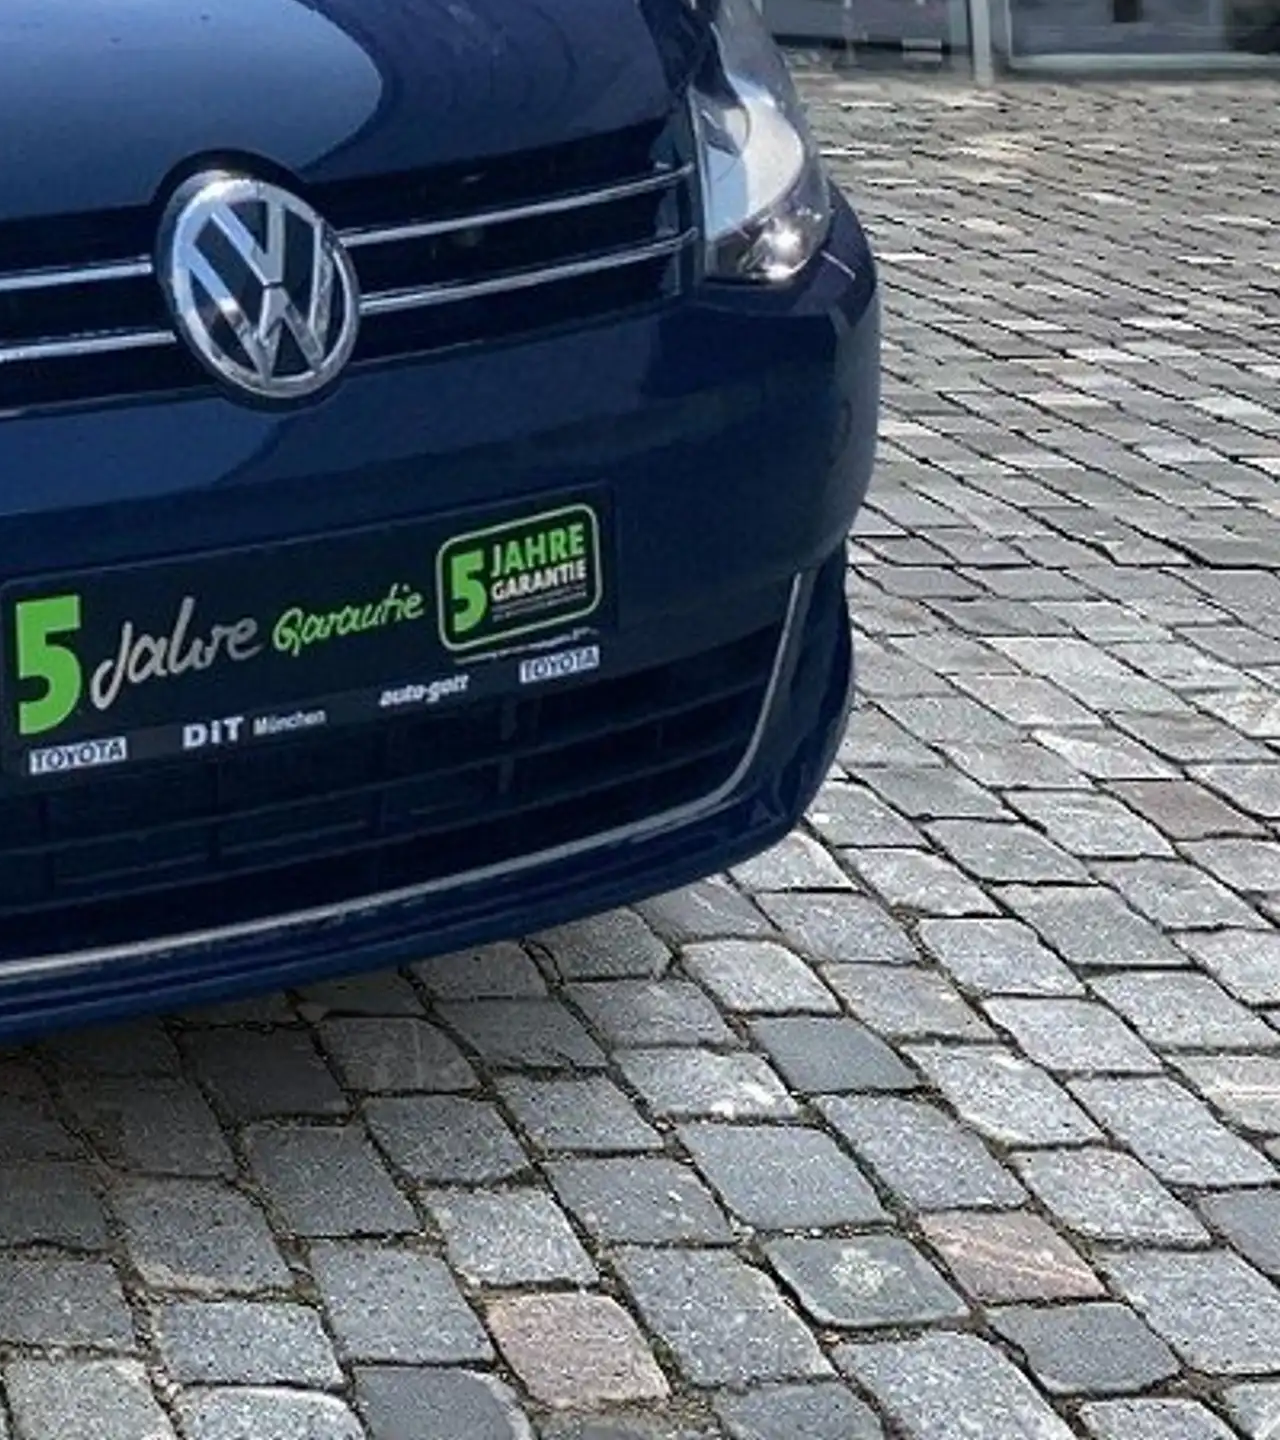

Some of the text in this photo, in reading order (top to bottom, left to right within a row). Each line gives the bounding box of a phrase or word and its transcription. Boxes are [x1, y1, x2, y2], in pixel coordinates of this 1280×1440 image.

[490, 522, 586, 579] JAHRE
[450, 548, 488, 634] 5
[491, 558, 588, 602] GARANTIE
[15, 594, 82, 736] 5
[88, 595, 264, 711] Jahre
[519, 646, 599, 683] TOYOTA
[253, 709, 326, 736] München
[30, 738, 126, 775] TOYOTA
